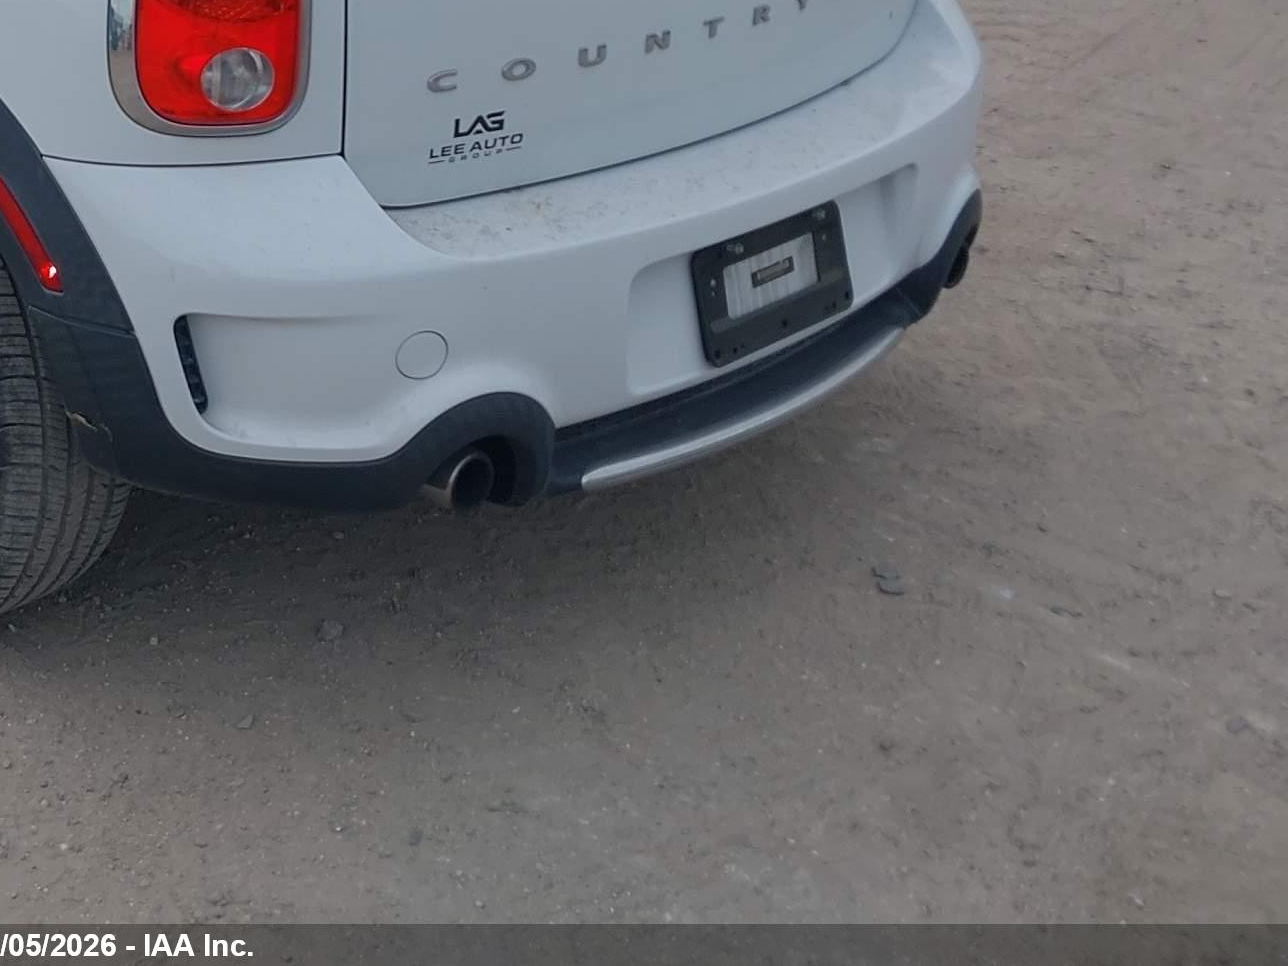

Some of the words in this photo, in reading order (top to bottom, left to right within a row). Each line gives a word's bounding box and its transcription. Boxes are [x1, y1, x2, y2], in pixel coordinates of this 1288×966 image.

[453, 110, 505, 138] LAG
[429, 143, 466, 159] LEE
[469, 133, 523, 152] AUTO
[448, 149, 503, 163] GROUP
